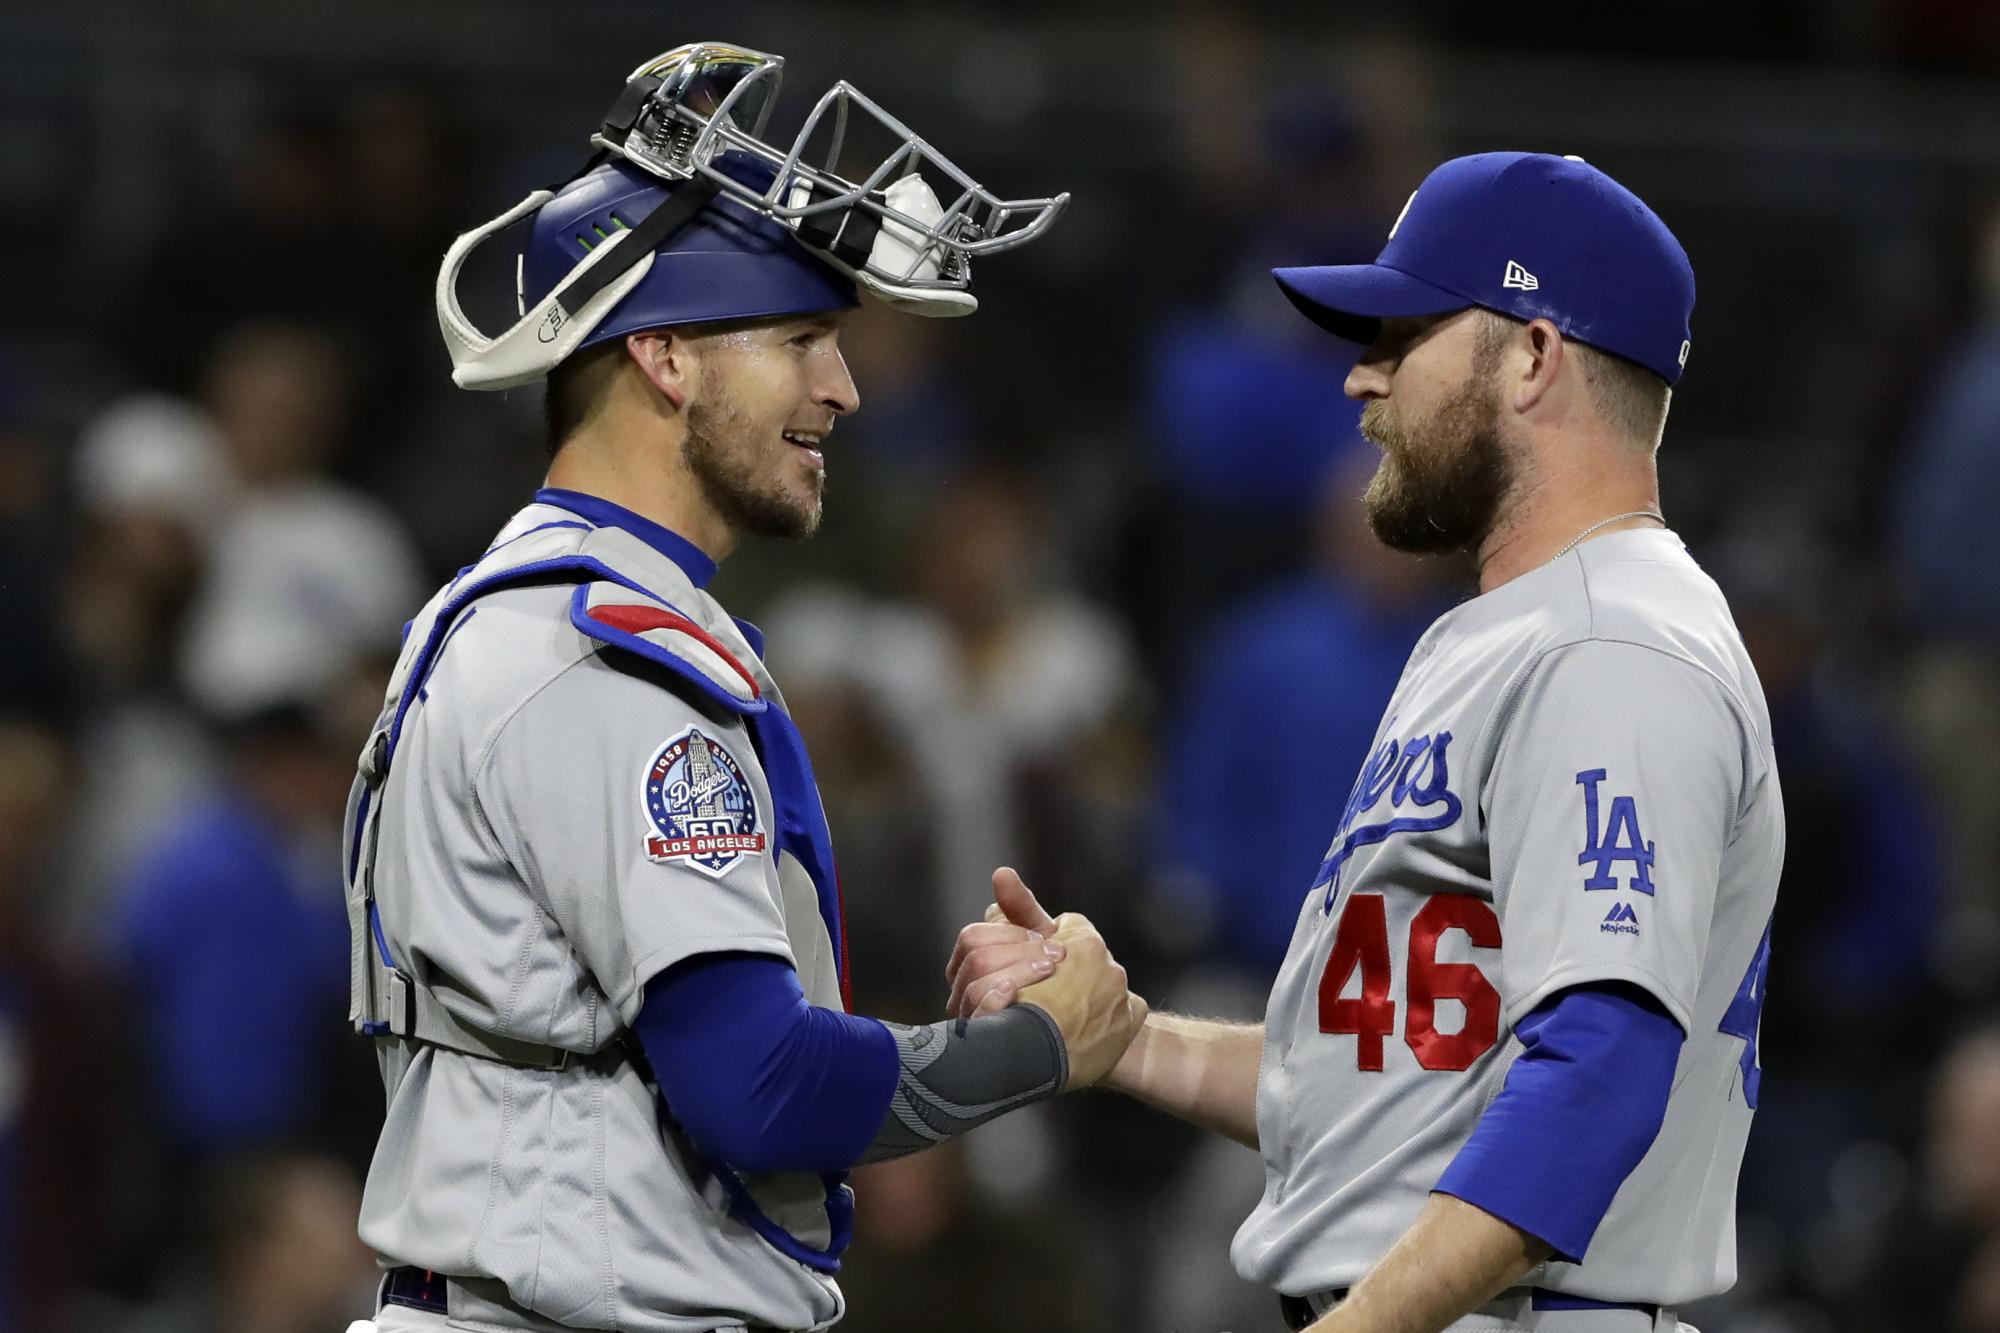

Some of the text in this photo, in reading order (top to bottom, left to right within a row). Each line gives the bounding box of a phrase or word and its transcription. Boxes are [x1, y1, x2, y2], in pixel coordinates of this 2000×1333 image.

[656, 745, 682, 773] 1958
[669, 768, 732, 809] Dodgers
[663, 837, 757, 854] LOS ANGELES
[1576, 768, 1655, 897] LA
[1318, 893, 1503, 1072] 46
